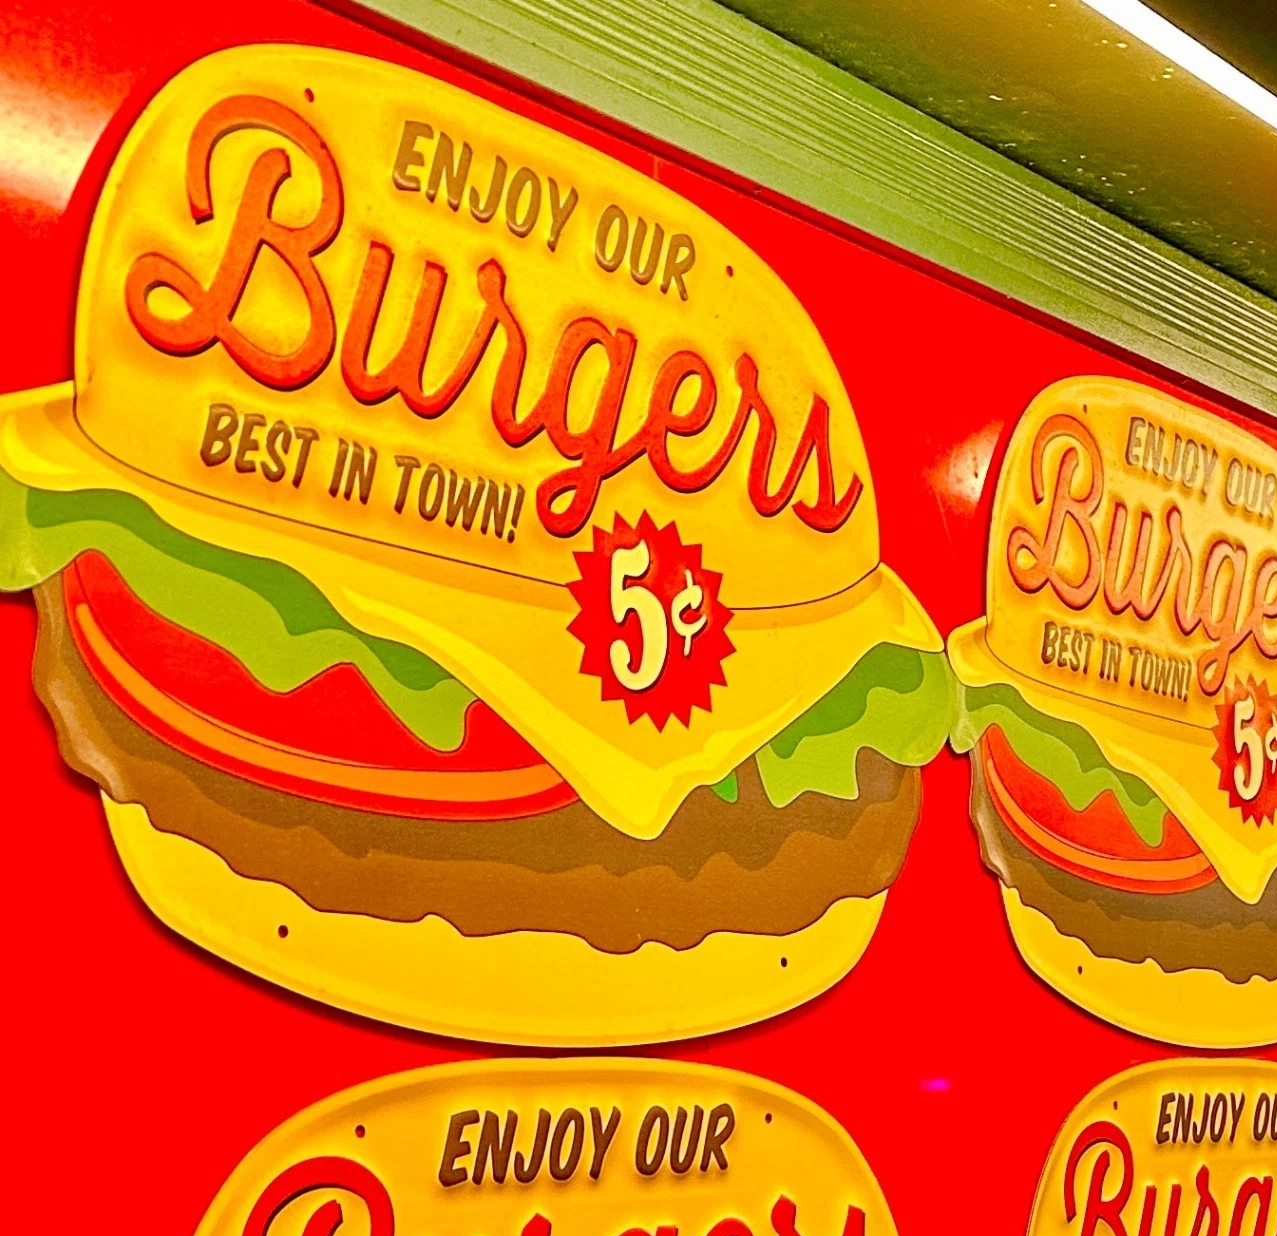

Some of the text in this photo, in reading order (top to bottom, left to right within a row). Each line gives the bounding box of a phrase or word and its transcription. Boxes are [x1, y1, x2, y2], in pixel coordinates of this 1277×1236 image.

[392, 120, 696, 301] ENJOY OUR
[124, 94, 865, 539] Burgers
[200, 402, 526, 543] BEST IN TOWN!
[1126, 418, 1277, 518] ENJOY OUR
[609, 540, 707, 690] 5¢
[1041, 622, 1190, 702] BEST IN TOWN!
[439, 1103, 736, 1188] ENJOY OUR
[1156, 1092, 1244, 1145] ENJOY
